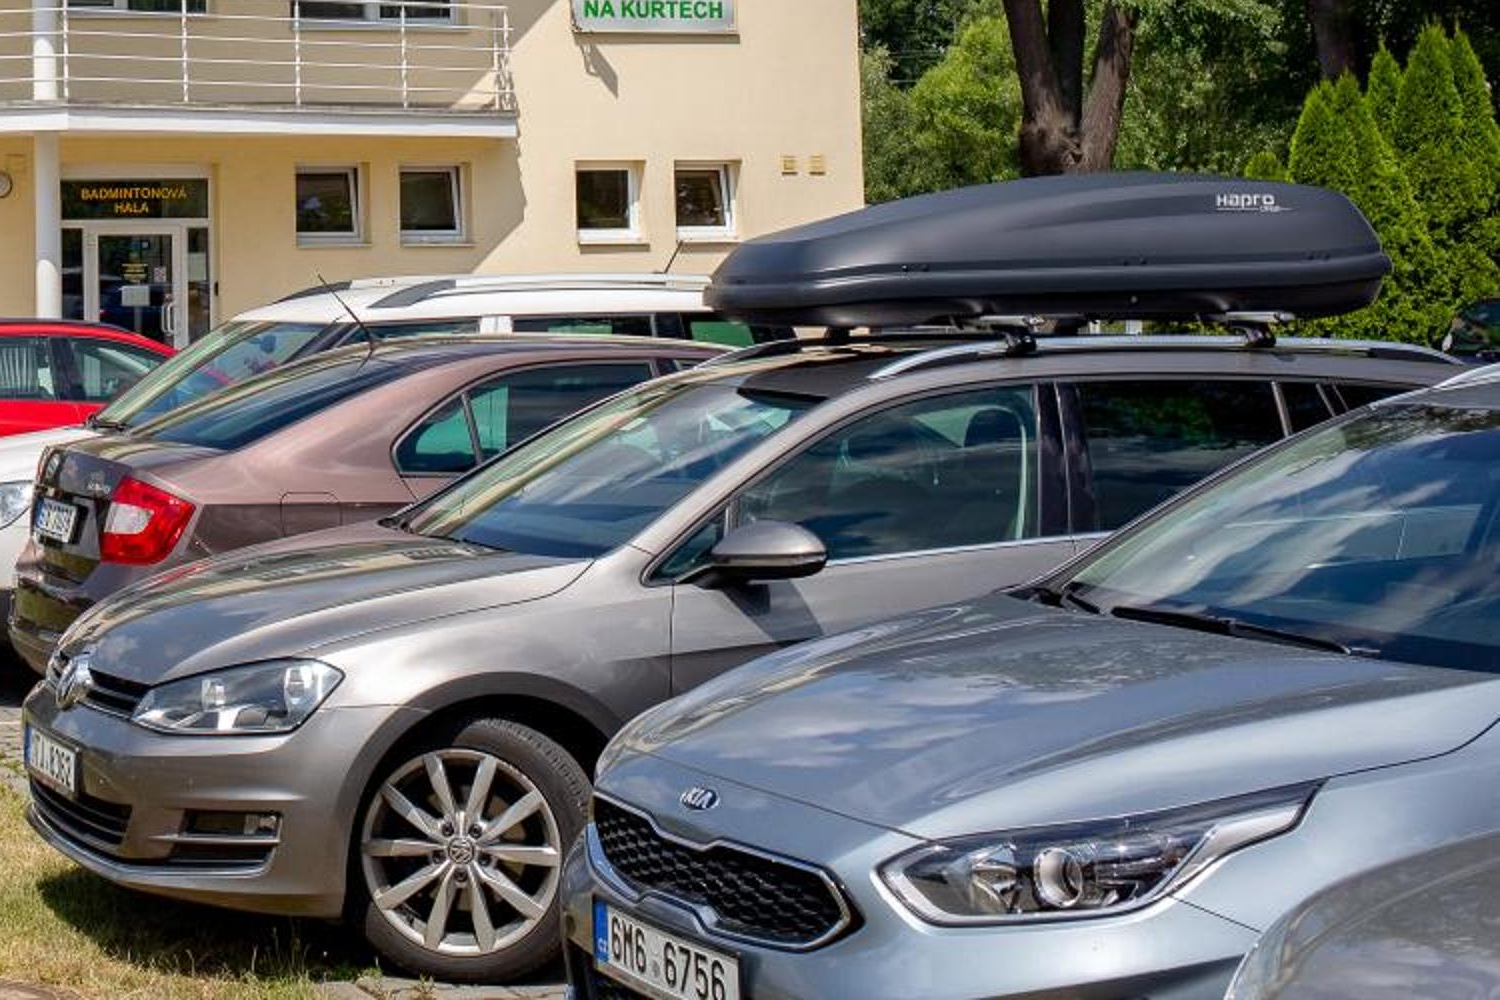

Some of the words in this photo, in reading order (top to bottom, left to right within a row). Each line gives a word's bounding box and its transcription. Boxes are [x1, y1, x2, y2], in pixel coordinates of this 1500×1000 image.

[583, 0, 615, 18] NA
[621, 1, 723, 19] KURTECH
[81, 185, 187, 200] BADMINTONOVÁ
[115, 202, 149, 213] HALA
[1216, 193, 1275, 210] Hapro
[611, 916, 647, 974] 6M6
[663, 941, 725, 1000] 6756
